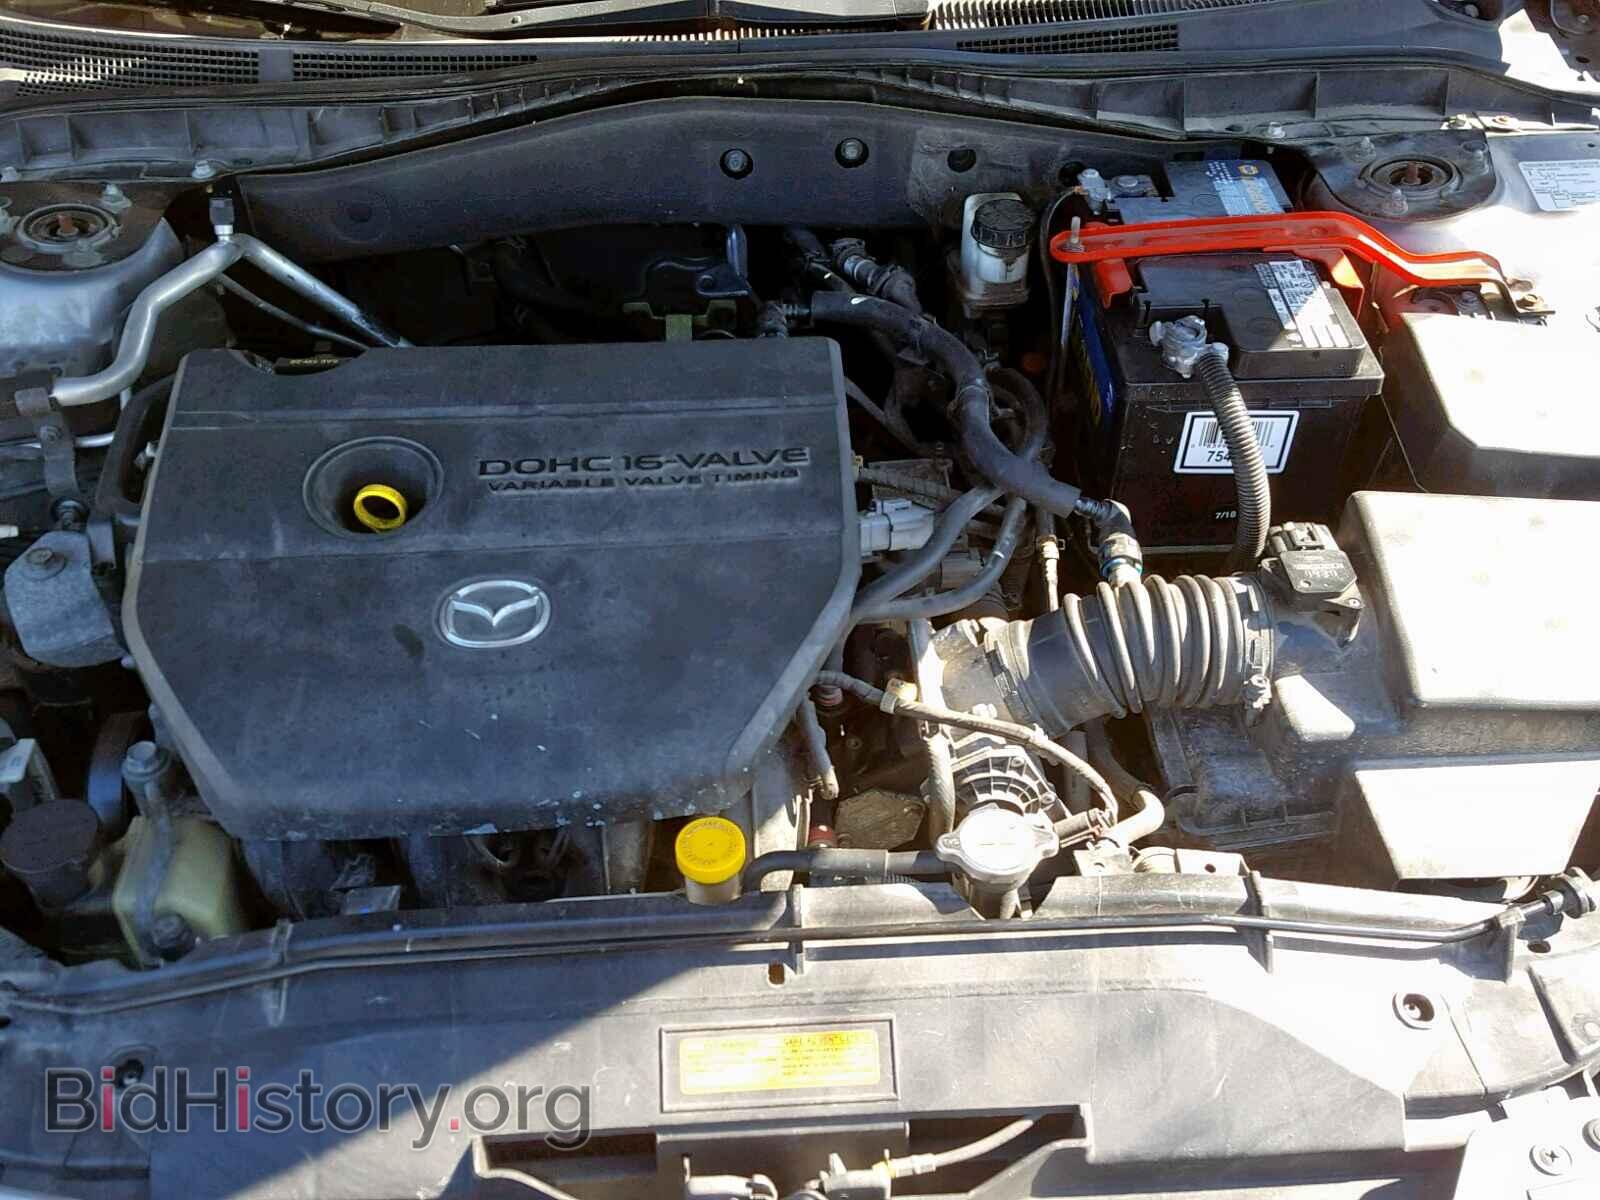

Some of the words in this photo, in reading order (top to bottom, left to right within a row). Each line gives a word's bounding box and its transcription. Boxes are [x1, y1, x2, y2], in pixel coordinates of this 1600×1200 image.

[479, 456, 613, 476] DOHC
[621, 447, 809, 471] 16-VALVE
[488, 478, 616, 492] VARIABLE
[624, 474, 703, 487] VALVE
[711, 467, 800, 483] TIMING
